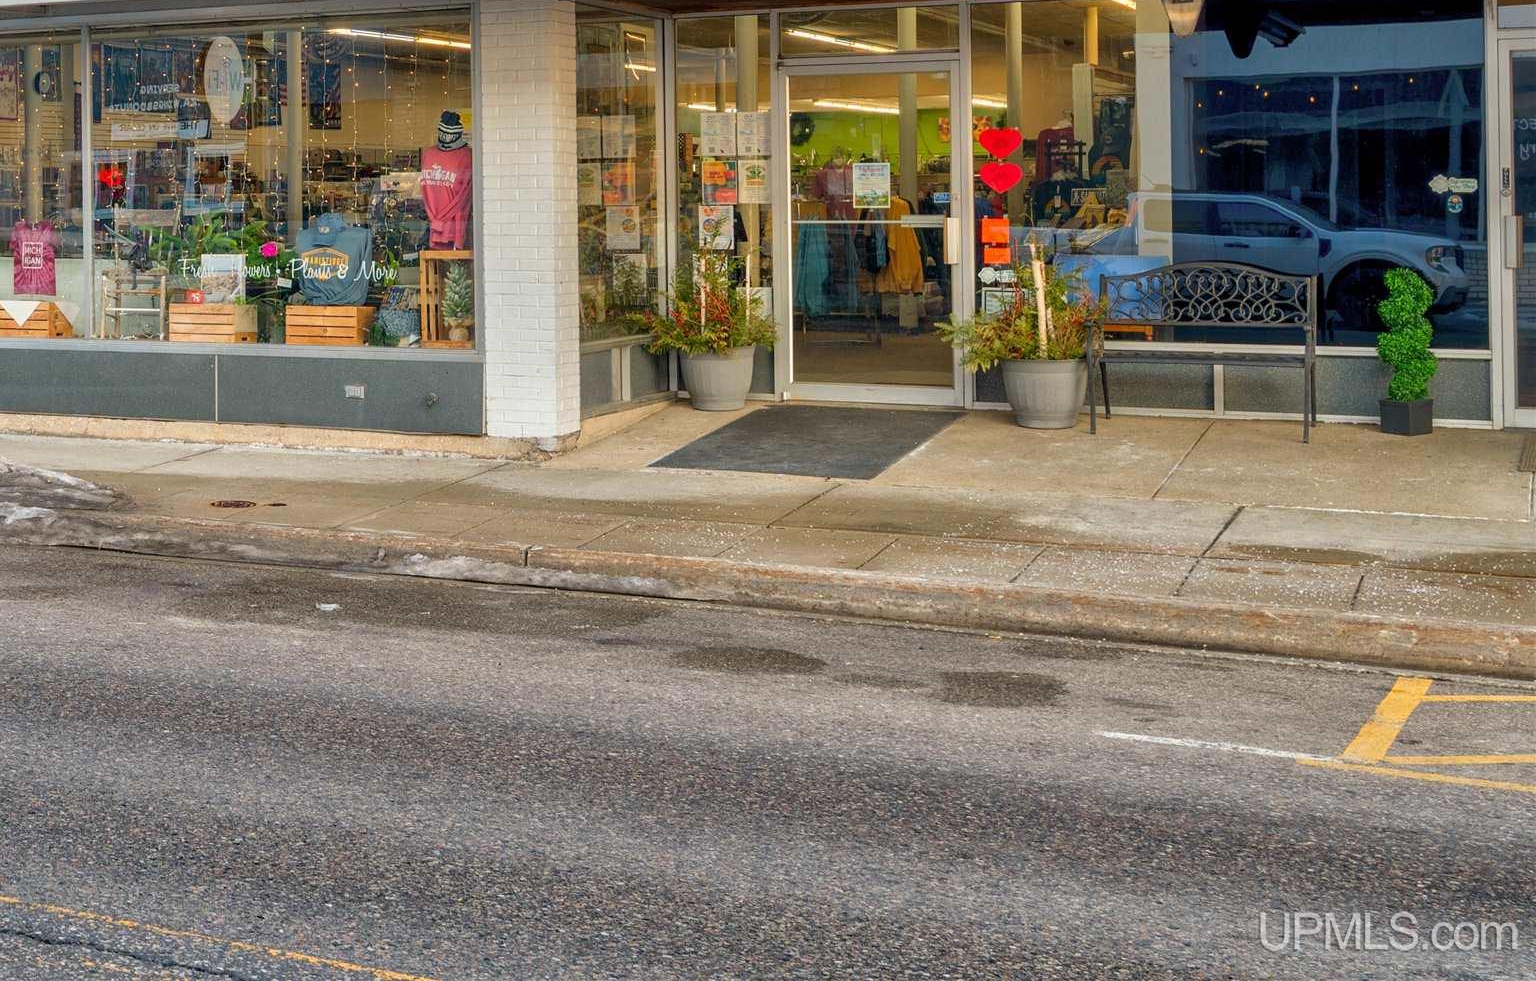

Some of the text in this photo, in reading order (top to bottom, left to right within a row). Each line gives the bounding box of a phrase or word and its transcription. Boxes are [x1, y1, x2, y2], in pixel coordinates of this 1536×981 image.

[24, 245, 41, 255] MICH
[24, 257, 41, 265] IGAN
[288, 258, 333, 280] Plants
[337, 263, 348, 280] &
[354, 262, 398, 281] More
